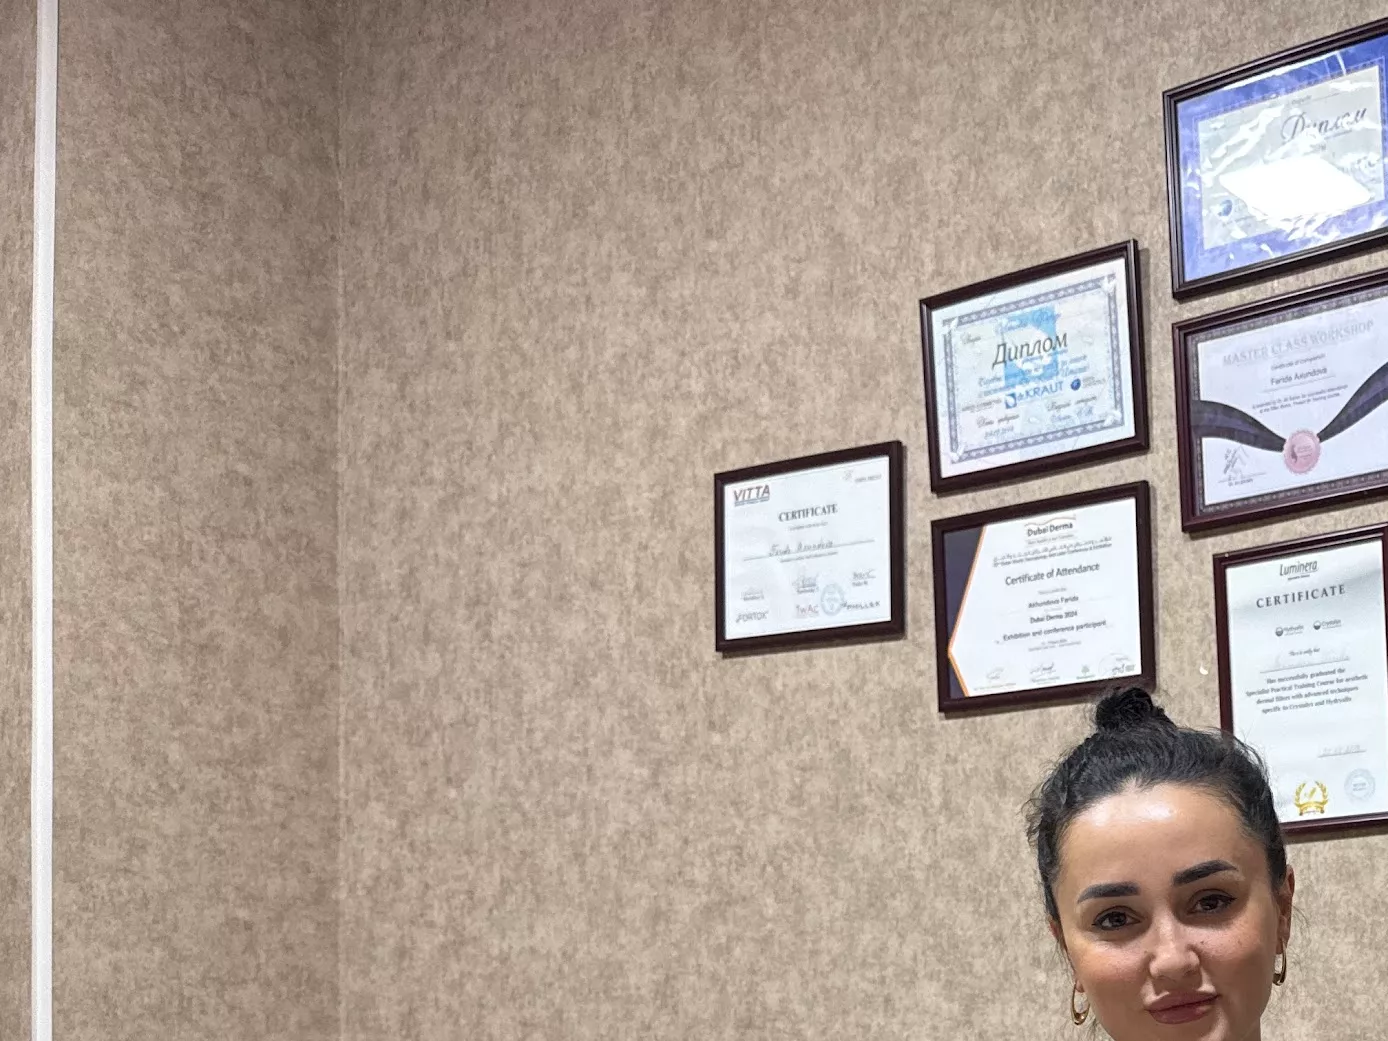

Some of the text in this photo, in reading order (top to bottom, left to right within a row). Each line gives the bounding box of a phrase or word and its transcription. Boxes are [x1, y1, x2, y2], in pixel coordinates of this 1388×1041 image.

[1309, 319, 1374, 344] WORKSHOP
[991, 332, 1069, 369] Диплом
[733, 484, 771, 501] VITTA
[778, 503, 838, 522] CERTIFICATE
[1027, 522, 1074, 537] Dubai Derma
[1005, 563, 1100, 586] Certificate of Attendance
[1279, 560, 1319, 576] Luminera
[1256, 584, 1346, 609] CERTIFICATE
[1030, 610, 1078, 624] Dubai Derma 2024
[1003, 619, 1107, 641] Exhibition and conference participant
[1304, 689, 1329, 698] advanced
